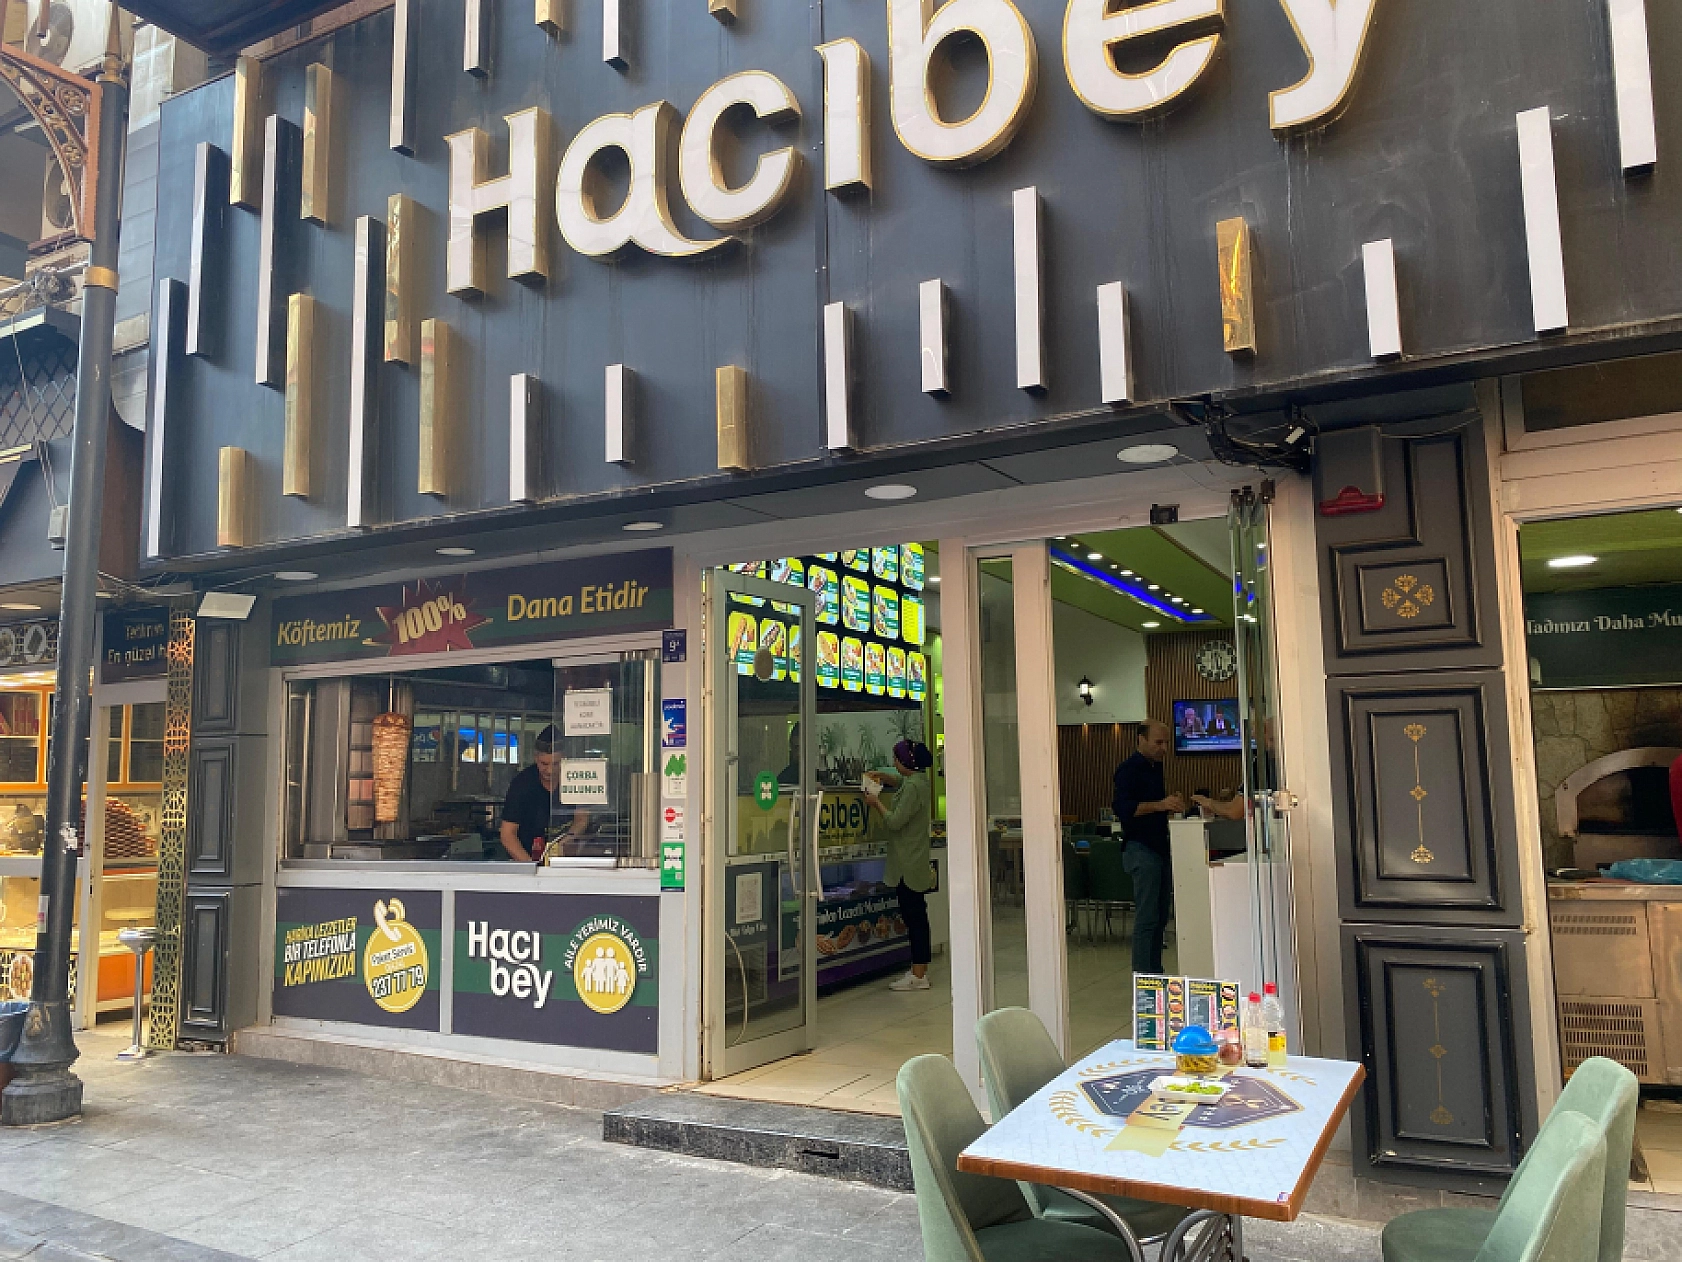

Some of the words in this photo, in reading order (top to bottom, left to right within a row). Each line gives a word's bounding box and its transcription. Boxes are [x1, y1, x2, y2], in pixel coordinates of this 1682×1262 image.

[277, 614, 361, 647] Köftemiz
[393, 591, 467, 645] 100%
[507, 594, 573, 622] Dana
[580, 579, 649, 614] Etidir
[1593, 613, 1644, 632] Daha
[819, 796, 870, 836] cıbey
[303, 932, 356, 960] TELEFONLA
[467, 921, 541, 964] Hacı
[575, 917, 620, 941] YERİMİZ
[620, 924, 647, 974] VARDIR
[489, 958, 554, 1009] bey
